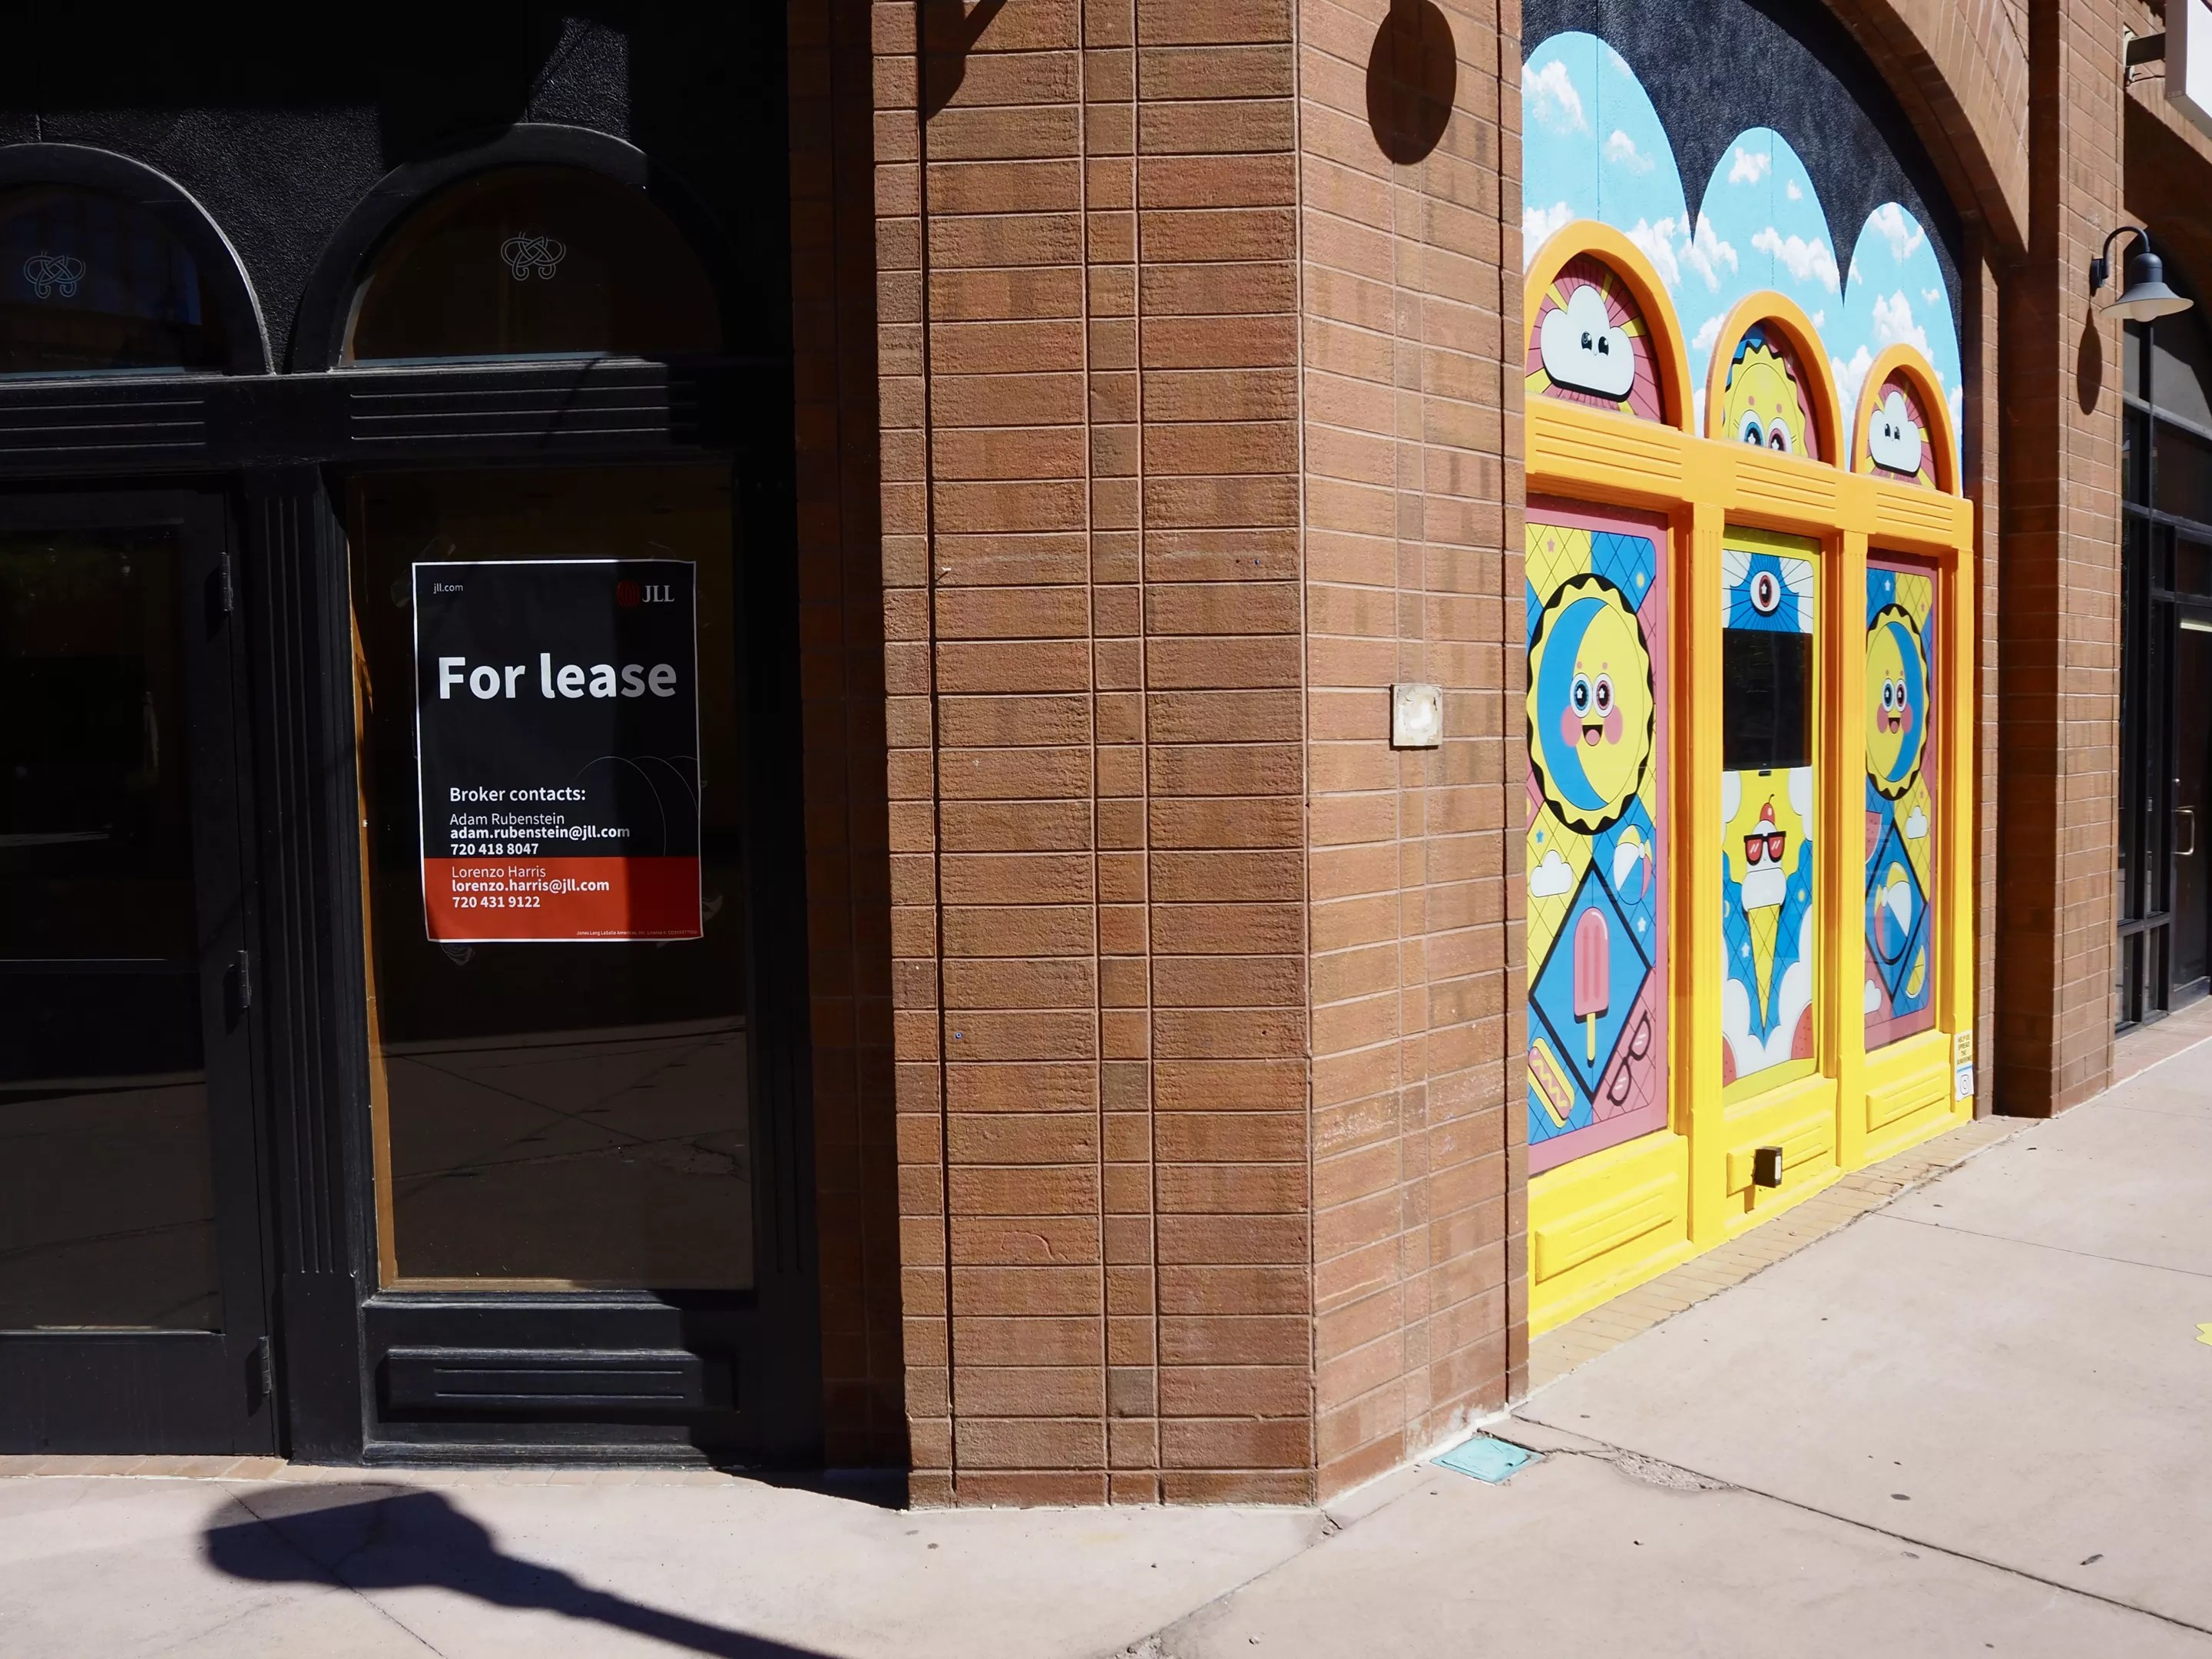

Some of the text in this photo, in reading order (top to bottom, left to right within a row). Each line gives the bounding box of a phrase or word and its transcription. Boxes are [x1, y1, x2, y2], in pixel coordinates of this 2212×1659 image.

[433, 583, 463, 594] jll.com
[642, 585, 674, 602] JLL
[439, 653, 677, 699] For lease
[450, 786, 585, 801] Broker contacts:
[450, 813, 565, 825] Adam Rubenstein
[450, 826, 630, 840] adam.rubenstein@jll.com
[451, 843, 539, 855] 720 418 8047
[452, 866, 546, 878] Lorenzo Harris
[452, 879, 609, 894] lorenzo.harris@jll.com
[452, 896, 541, 908] 720 431 9122
